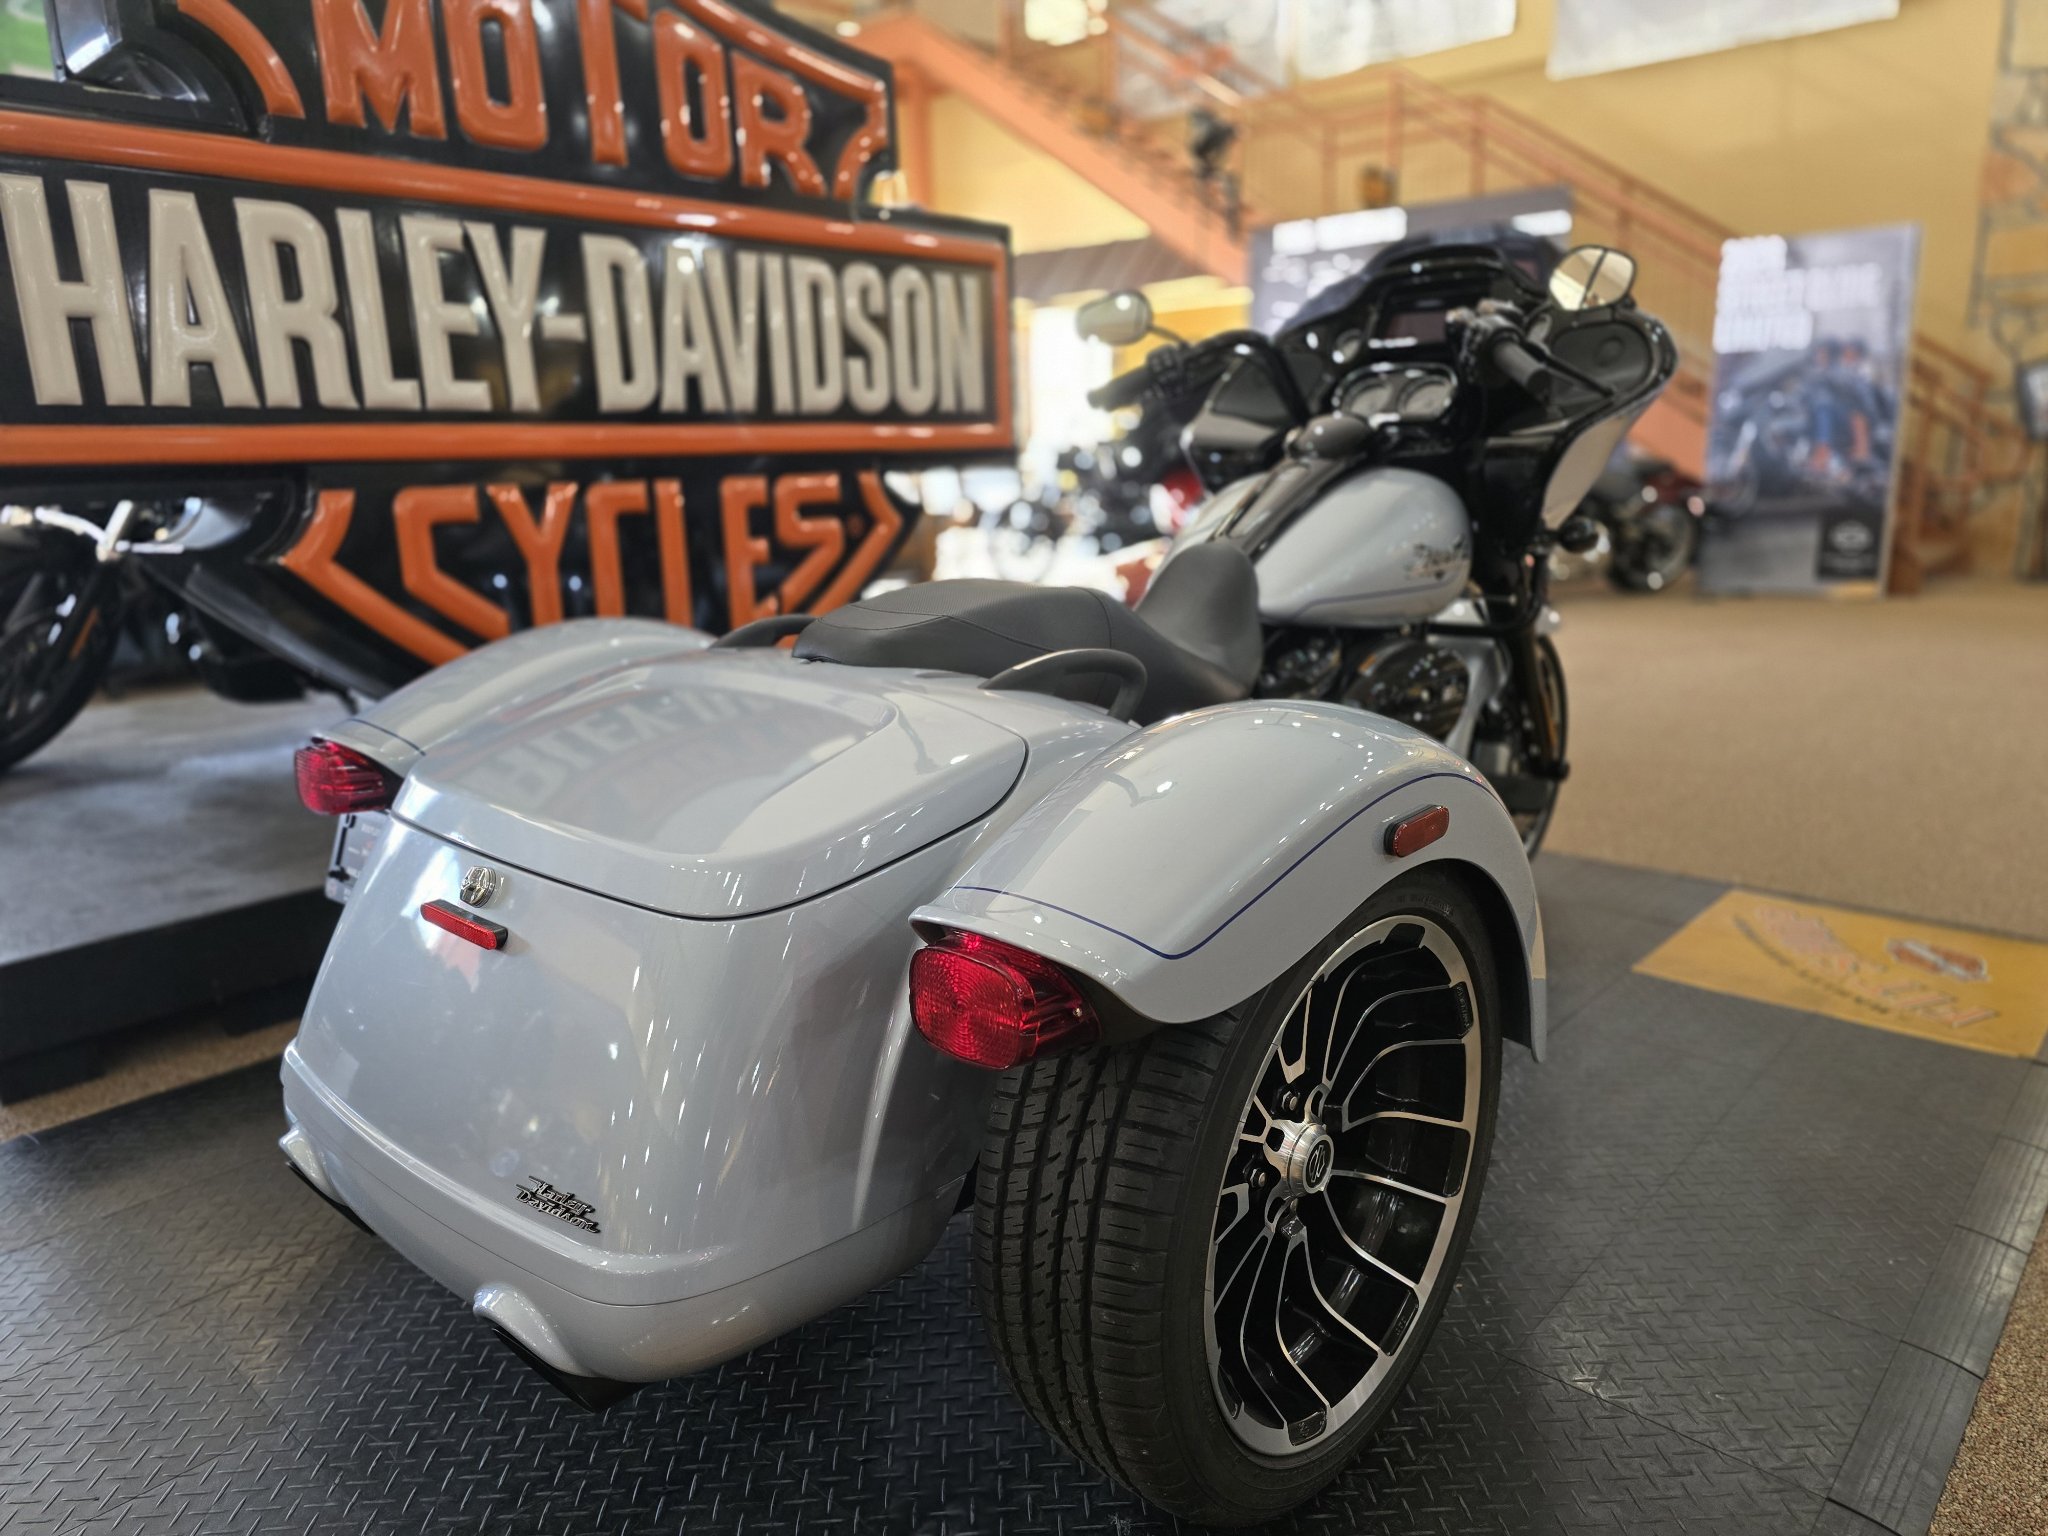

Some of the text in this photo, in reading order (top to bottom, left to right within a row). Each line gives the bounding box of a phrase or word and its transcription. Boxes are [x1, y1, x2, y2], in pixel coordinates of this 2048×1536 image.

[312, 0, 828, 196] MOTOR
[0, 172, 985, 415] HARLEY-DAVIDSON
[514, 1183, 601, 1234] Davidson
[528, 1175, 596, 1216] Harley
